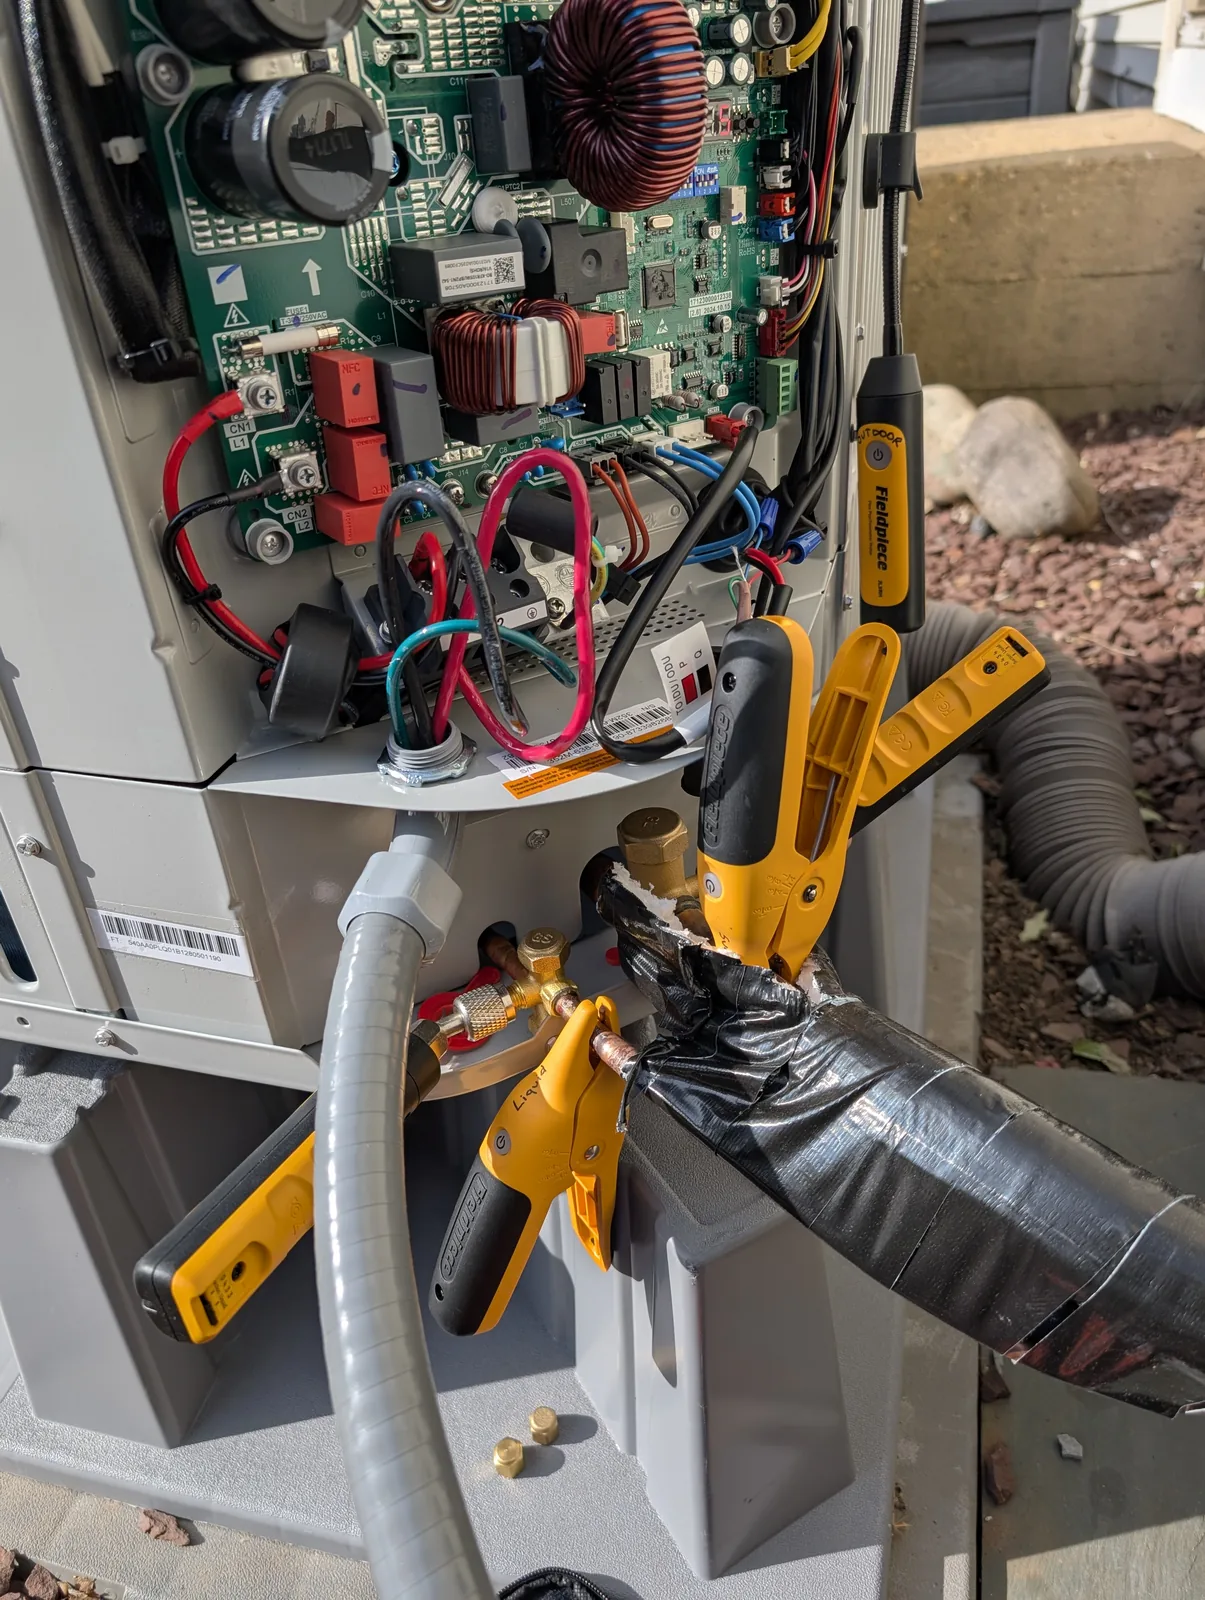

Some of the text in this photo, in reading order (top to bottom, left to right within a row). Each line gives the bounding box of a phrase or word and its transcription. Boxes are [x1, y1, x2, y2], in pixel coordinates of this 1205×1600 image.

[450, 78, 464, 86] C11
[342, 363, 360, 374] NFC
[230, 423, 251, 434] CN1
[234, 438, 246, 449] L1
[458, 469, 469, 477] J14
[287, 510, 308, 520] CN2
[298, 522, 310, 531] L2
[875, 486, 889, 571] Fieldpiece
[694, 649, 702, 659] Q
[520, 764, 538, 775] S/N
[512, 1065, 547, 1112] Liquid
[444, 1176, 488, 1277] Fieldpiece
